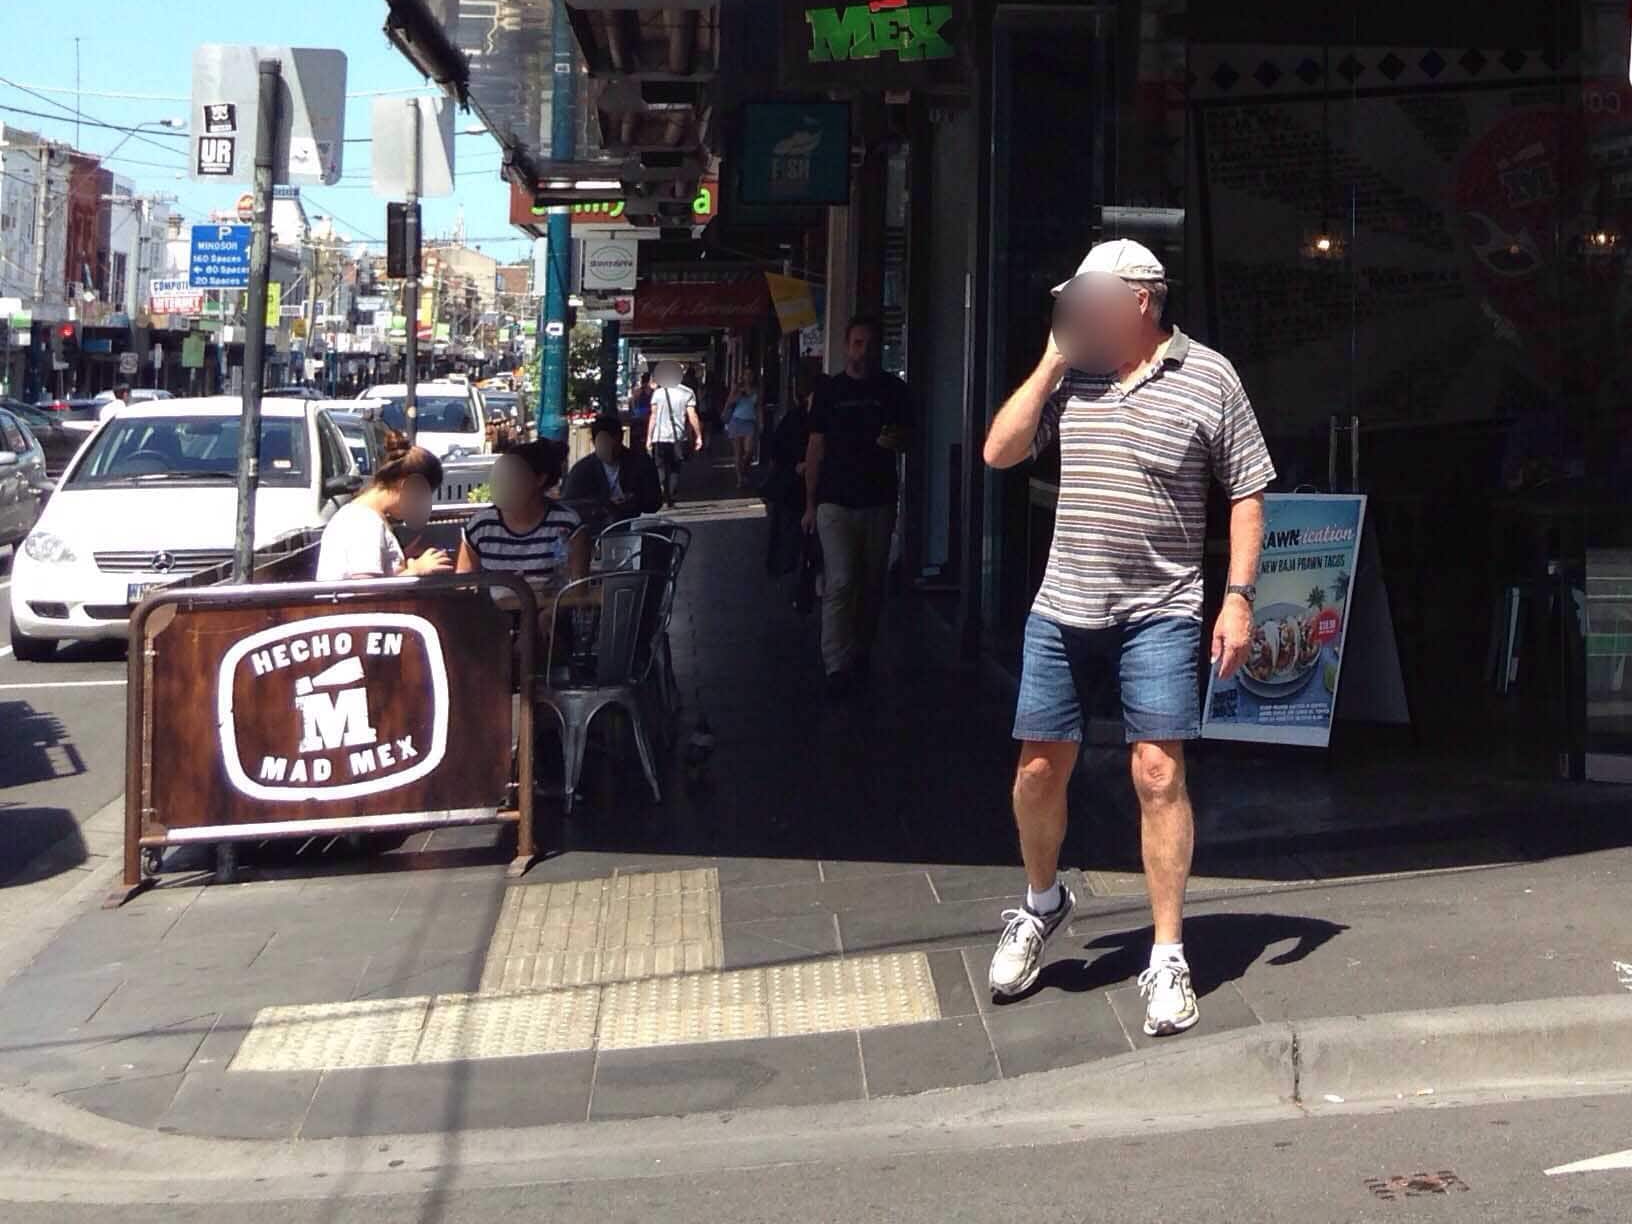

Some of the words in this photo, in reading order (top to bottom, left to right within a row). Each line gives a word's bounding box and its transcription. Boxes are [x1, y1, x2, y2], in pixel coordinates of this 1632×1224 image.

[805, 3, 956, 62] MEX
[201, 139, 231, 163] UR
[198, 241, 238, 250] WINDSOR
[211, 254, 242, 264] Spaces
[251, 633, 353, 676] HECHO
[366, 632, 403, 656] EN
[260, 756, 332, 783] MAD
[350, 735, 418, 776] MEX
